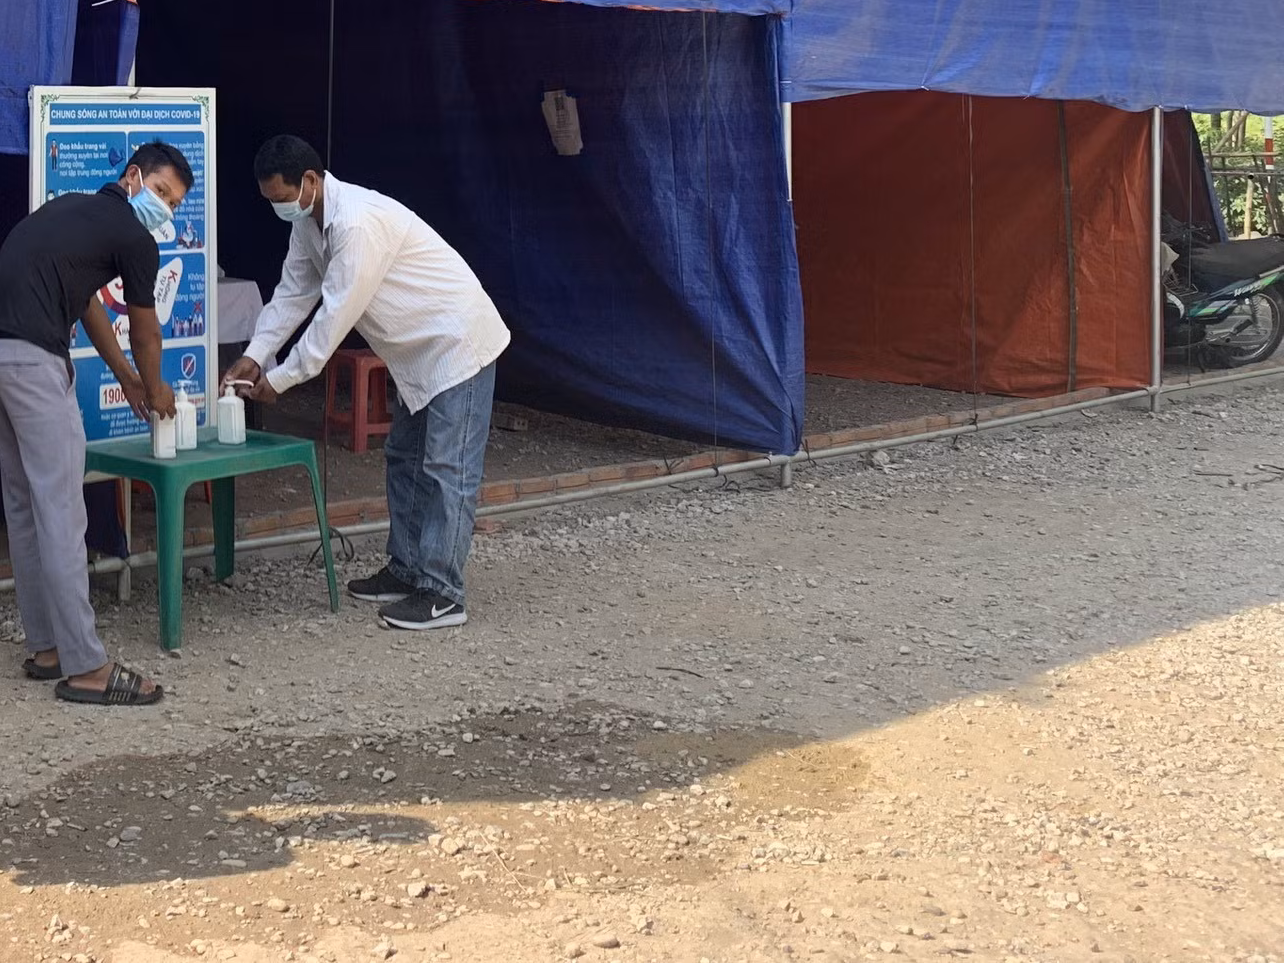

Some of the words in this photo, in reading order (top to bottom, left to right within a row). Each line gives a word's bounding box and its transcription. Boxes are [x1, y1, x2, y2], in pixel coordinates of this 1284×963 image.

[51, 109, 76, 119] CHUNG
[77, 108, 98, 119] SỐNG
[98, 110, 108, 119] AN
[109, 108, 127, 119] TOÀN
[128, 108, 141, 119] VỚI
[141, 110, 153, 121] ĐẠI
[154, 110, 171, 121] DỊCH
[171, 110, 200, 119] COVID-19
